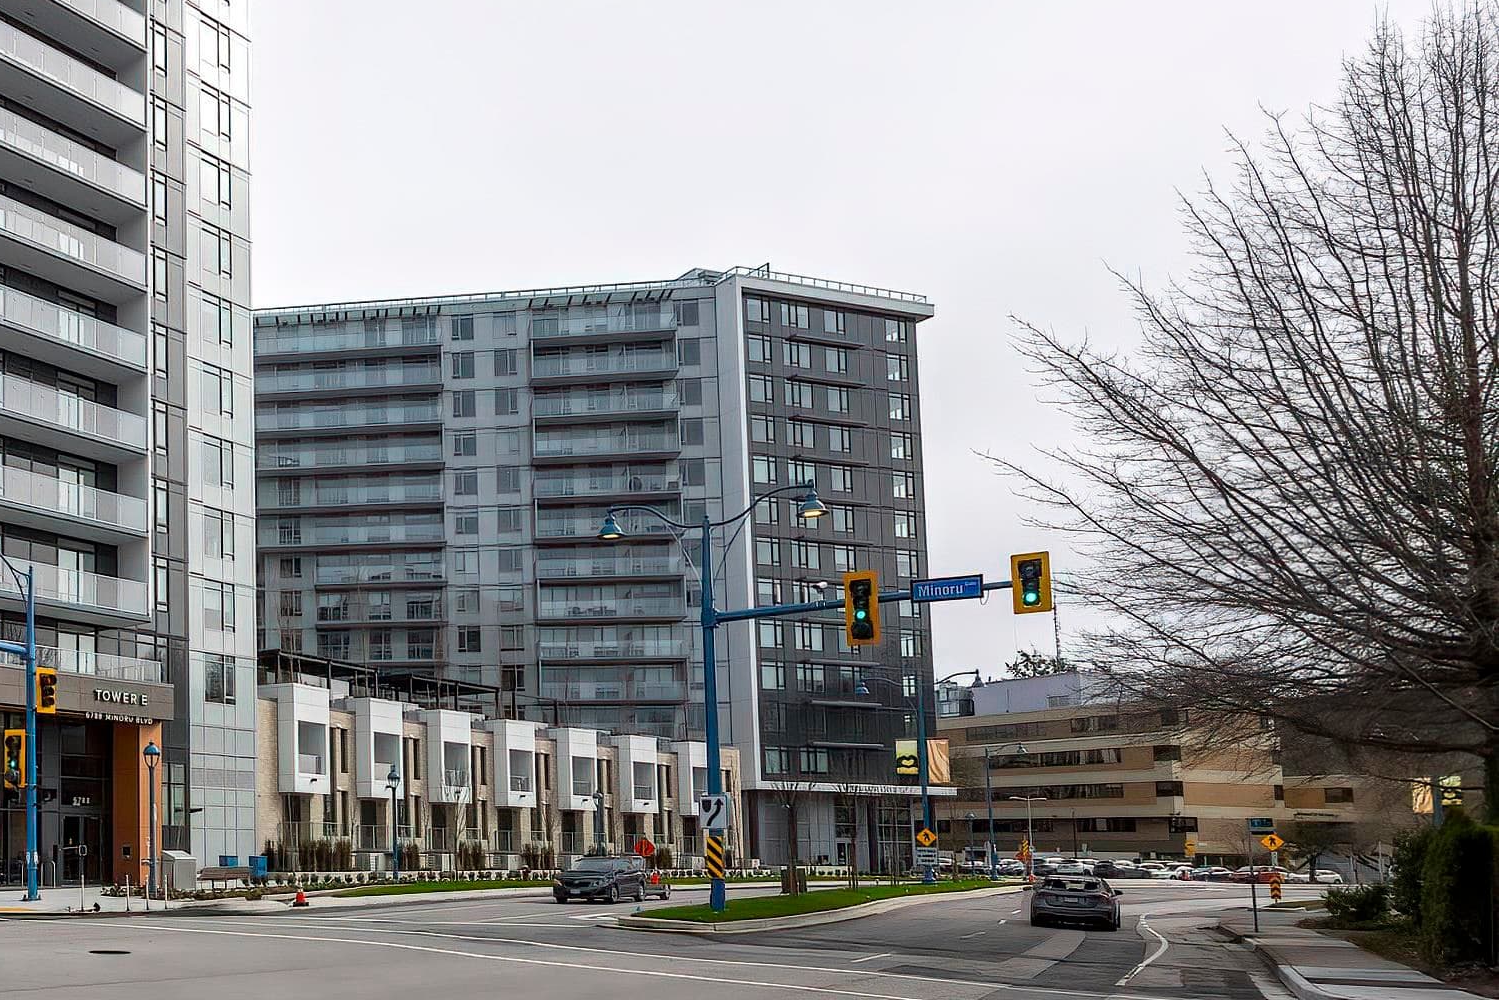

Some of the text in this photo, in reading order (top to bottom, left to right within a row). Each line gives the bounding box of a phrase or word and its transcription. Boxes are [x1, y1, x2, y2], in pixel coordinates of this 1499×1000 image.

[918, 583, 963, 597] Minoru
[95, 689, 148, 706] TOWER E
[105, 714, 134, 723] MINORU
[136, 716, 153, 725] BLVD
